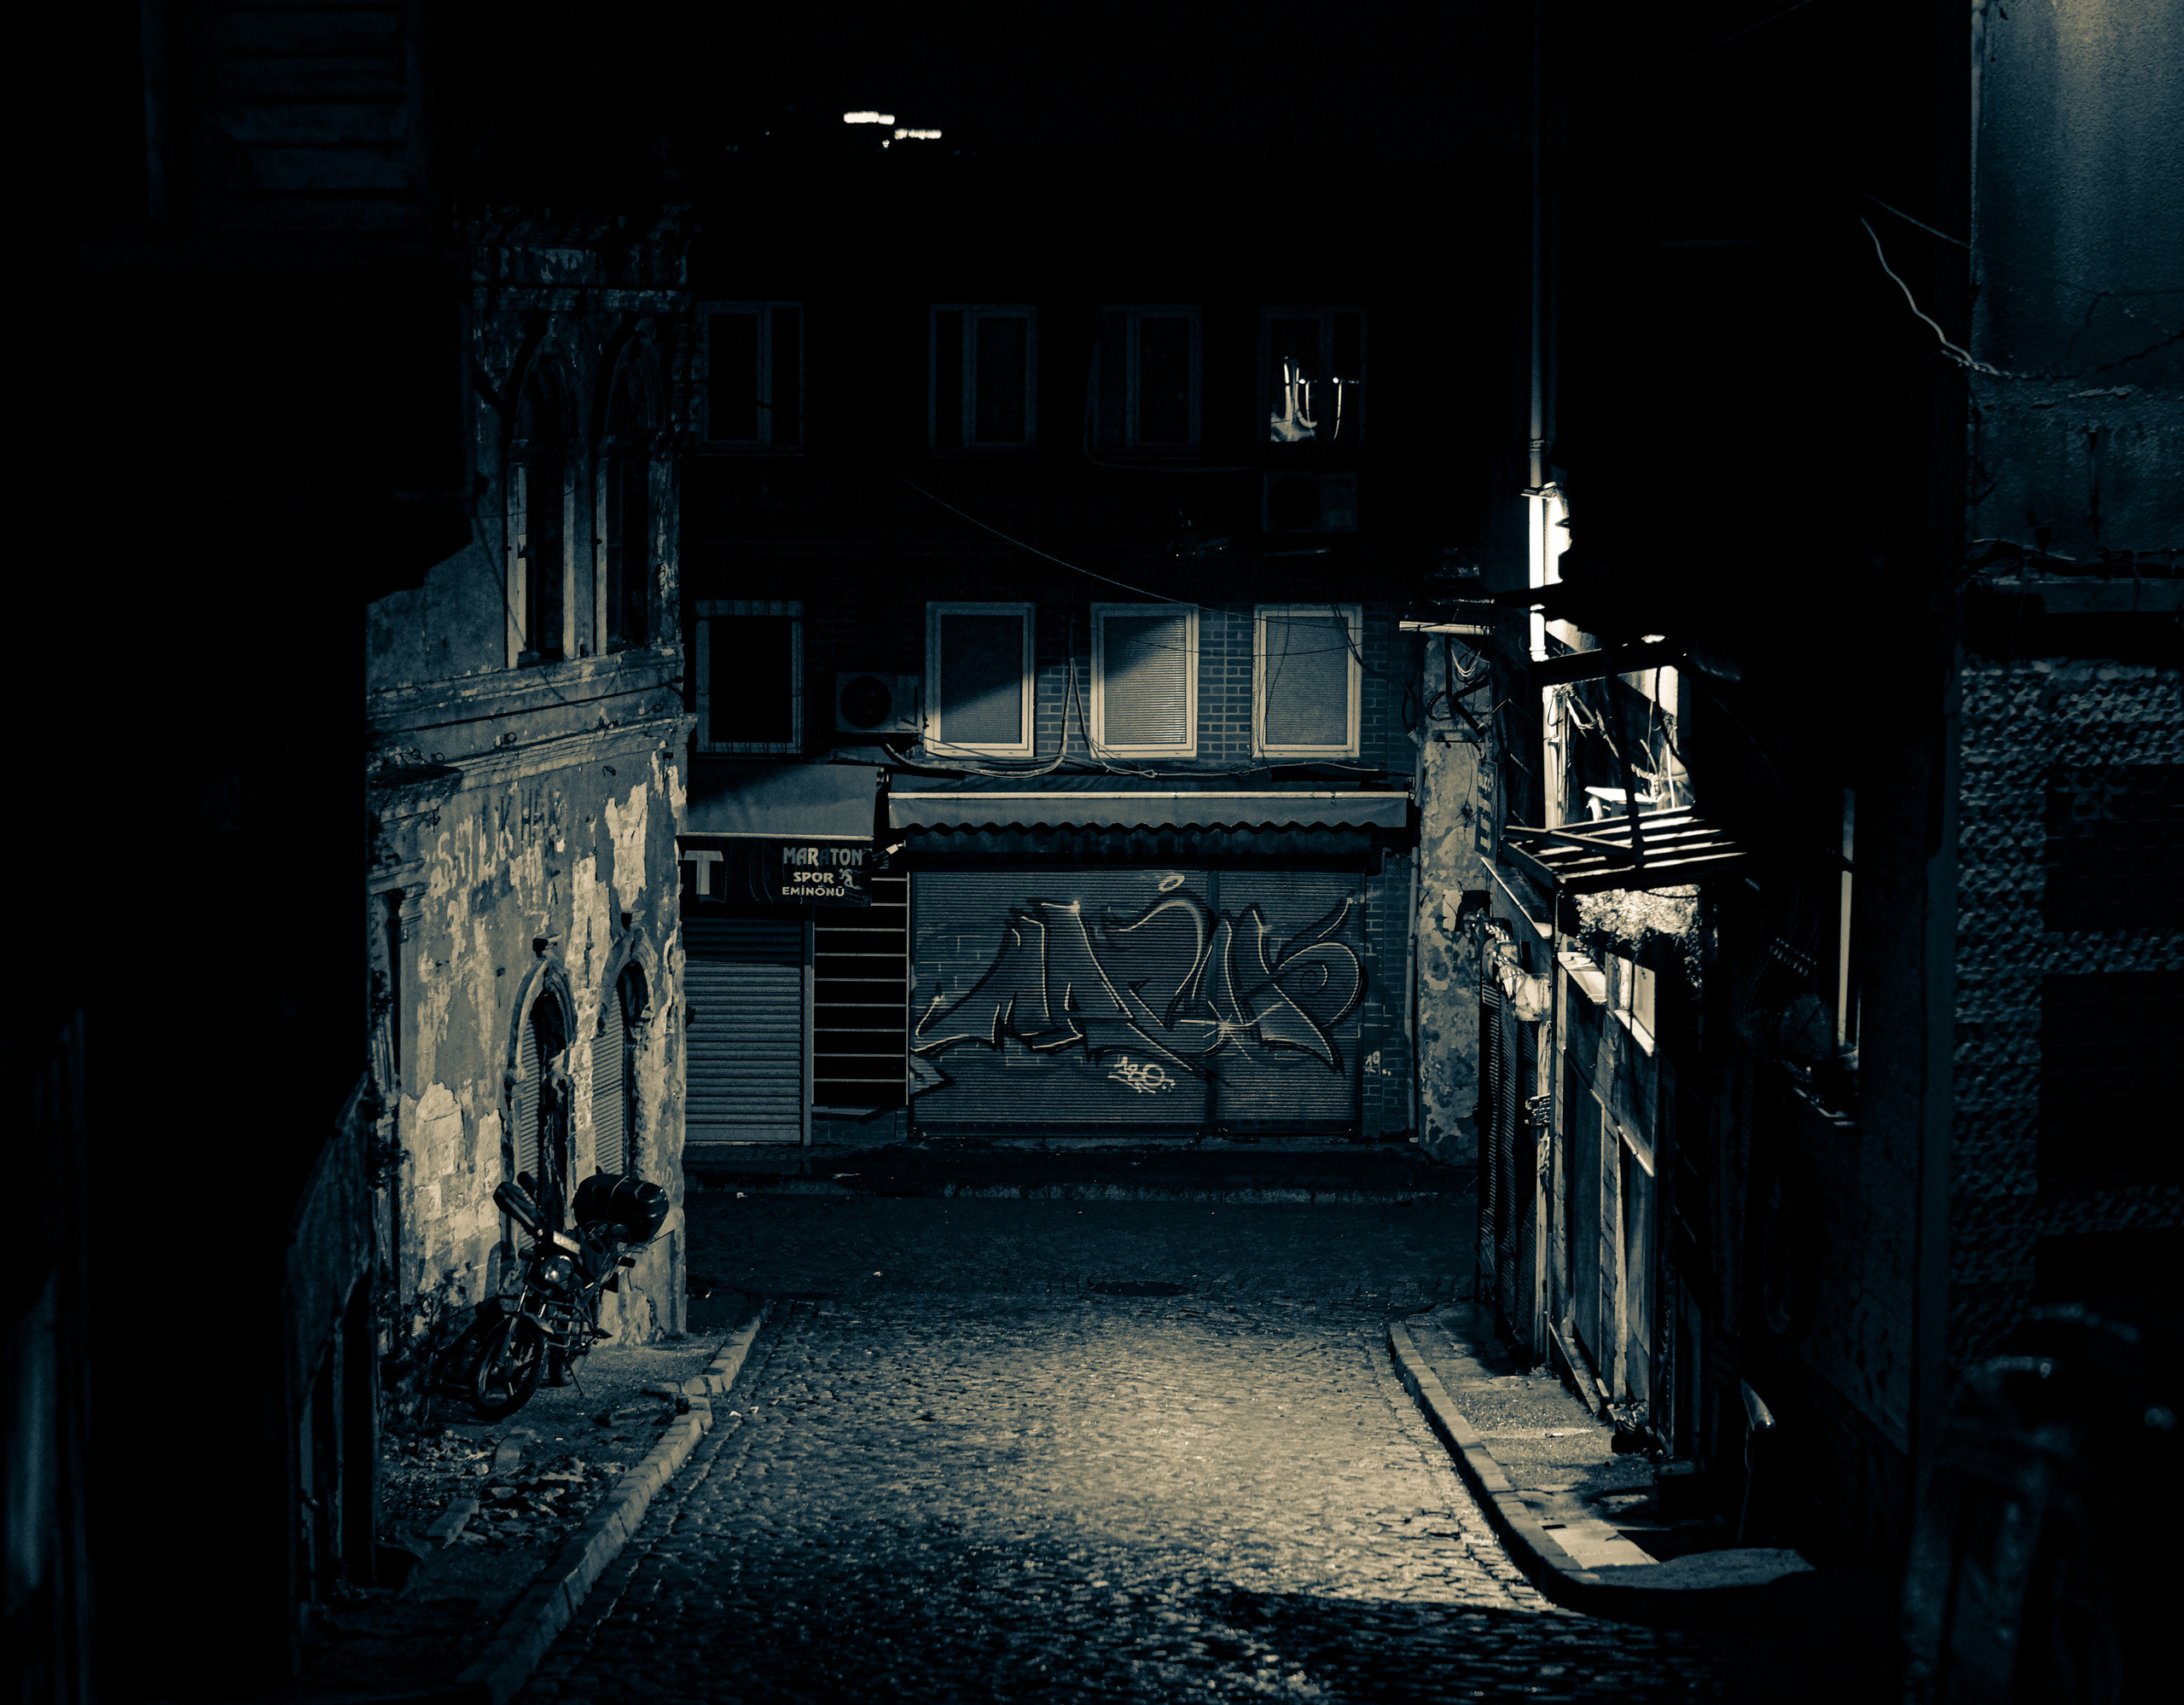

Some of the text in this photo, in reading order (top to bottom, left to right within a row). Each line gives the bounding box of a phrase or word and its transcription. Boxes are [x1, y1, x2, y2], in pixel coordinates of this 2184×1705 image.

[782, 847, 863, 867] MARATON
[793, 872, 834, 884] SPOR
[781, 884, 845, 897] EMİNÖNÜ
